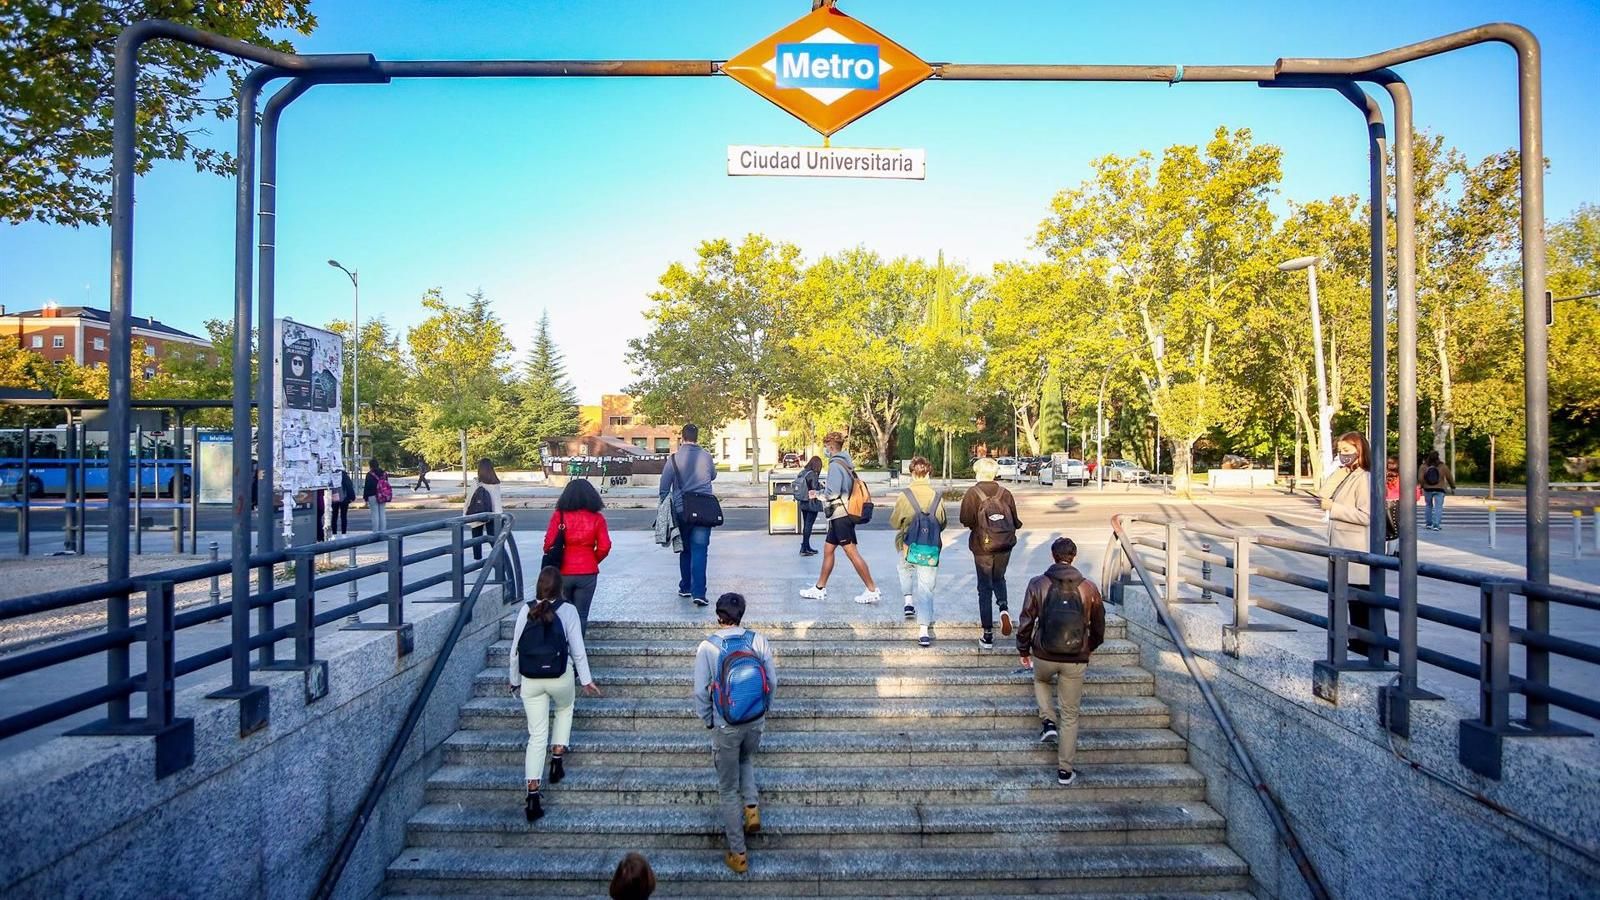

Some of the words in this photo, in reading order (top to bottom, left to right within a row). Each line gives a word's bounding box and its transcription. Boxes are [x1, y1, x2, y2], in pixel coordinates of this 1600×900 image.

[783, 52, 874, 80] Metro
[740, 150, 800, 169] Ciudad
[807, 152, 913, 172] Universitaria
